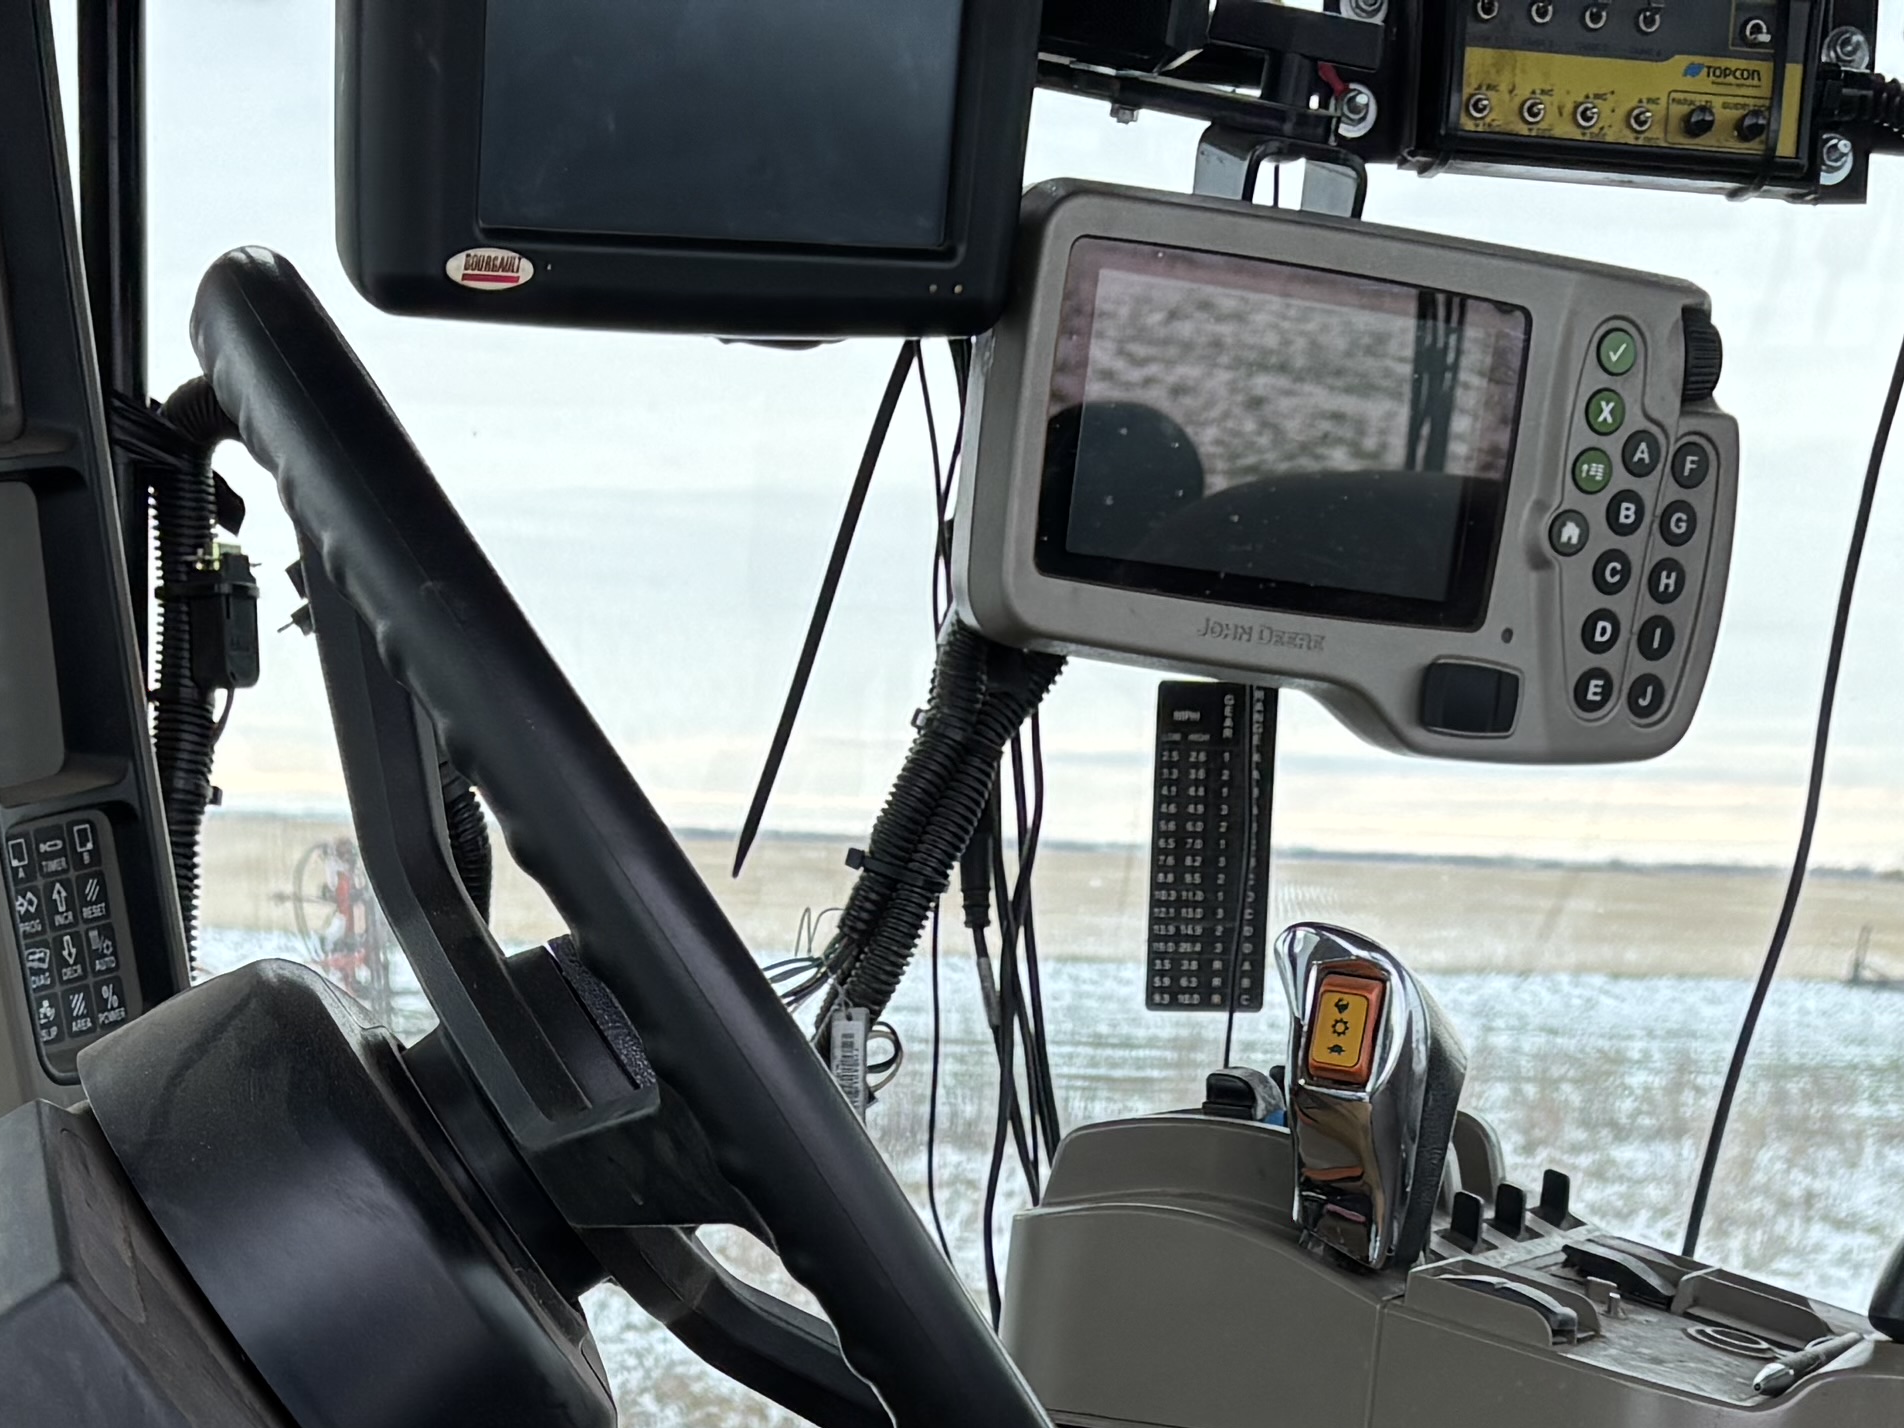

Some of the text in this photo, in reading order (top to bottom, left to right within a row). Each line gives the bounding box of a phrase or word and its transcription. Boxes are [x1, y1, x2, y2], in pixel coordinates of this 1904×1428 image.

[1706, 65, 1761, 81] TOPCON
[464, 253, 522, 273] BOURGAULT
[1633, 442, 1650, 464] A
[1684, 456, 1698, 475] F
[1619, 503, 1635, 523] B
[1670, 513, 1687, 533] G
[1605, 562, 1621, 584] C
[1659, 572, 1676, 594] H
[1197, 618, 1326, 650] JOHN DEERE
[1595, 621, 1611, 642] D
[1652, 628, 1662, 649] I
[1587, 681, 1603, 701] E
[1639, 685, 1652, 706] J
[18, 868, 25, 878] A
[42, 857, 67, 872] TIMER
[54, 911, 73, 926] INCR
[83, 904, 106, 919] RESET
[20, 920, 42, 934] PROG
[95, 957, 116, 970] AUTO
[1242, 962, 1251, 970] A
[31, 974, 51, 988] DIAG
[62, 966, 83, 981] DECR
[1240, 995, 1250, 1004] C
[98, 1008, 126, 1025] POWER
[72, 1018, 92, 1033] AREA
